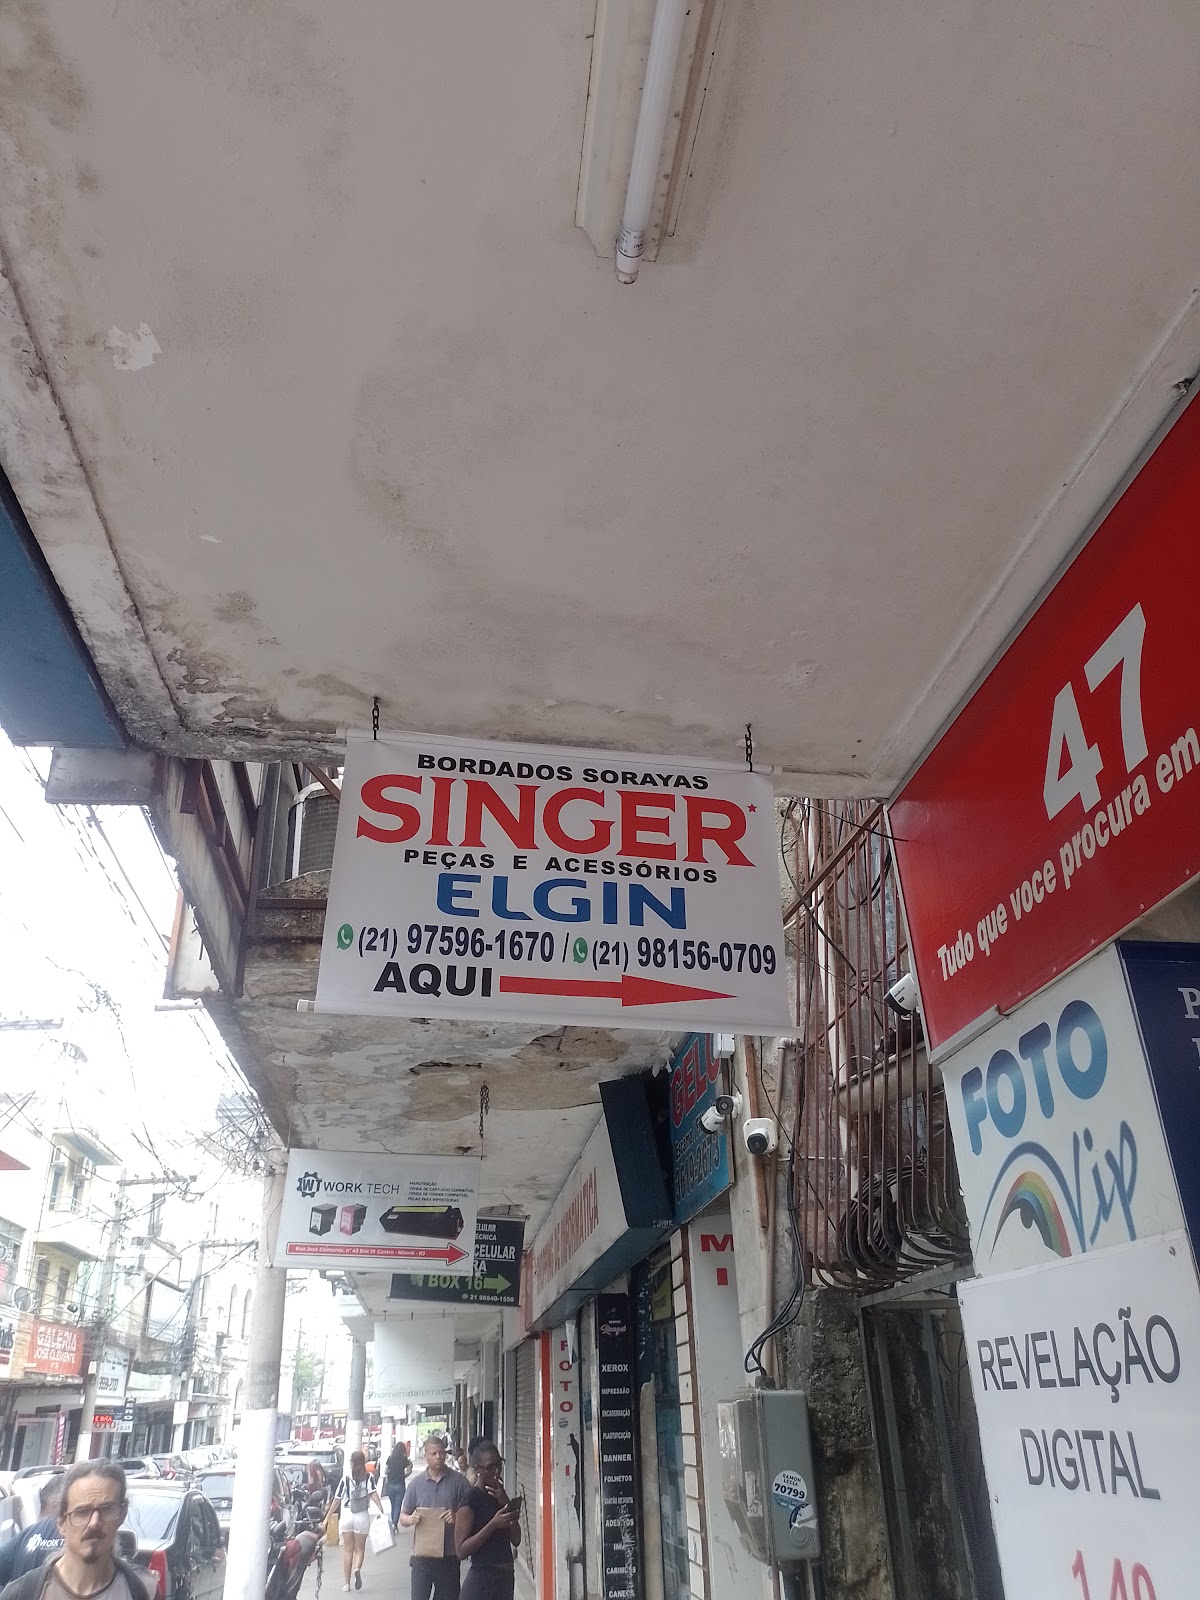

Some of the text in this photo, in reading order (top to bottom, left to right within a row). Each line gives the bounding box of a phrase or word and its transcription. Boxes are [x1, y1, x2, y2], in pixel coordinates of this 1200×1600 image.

[1043, 601, 1149, 820] 47
[417, 753, 709, 791] BORDADOS SORAYAS
[356, 774, 756, 867] SINGER
[403, 848, 718, 884] PEÇAS E ACESSÓRIOS
[936, 727, 1200, 982] Tudo que voce procura em
[436, 872, 688, 930] ELGIN
[358, 925, 399, 959] (21)
[406, 923, 555, 963] 97596-1670
[592, 939, 629, 972] (21)
[638, 935, 777, 975] 98156-0709
[373, 962, 493, 999] AQUI
[960, 999, 1108, 1156] FOTO
[324, 1181, 363, 1193] WORK
[366, 1183, 400, 1195] TECH
[475, 1222, 496, 1233] ELULAR
[475, 1233, 497, 1241] ÉCNICA
[474, 1243, 516, 1260] CELULAR
[428, 1275, 484, 1291] BOX 16
[37, 1325, 77, 1352] GALERIA
[601, 1364, 629, 1373] XEROX
[977, 1306, 1181, 1404] REVELAÇÃO
[601, 1387, 630, 1395] IMPRESSÃO
[603, 1454, 632, 1463] BANNER
[1019, 1428, 1161, 1501] DIGITAL
[604, 1475, 632, 1483] FOLHETOS
[774, 1482, 805, 1499] 70799
